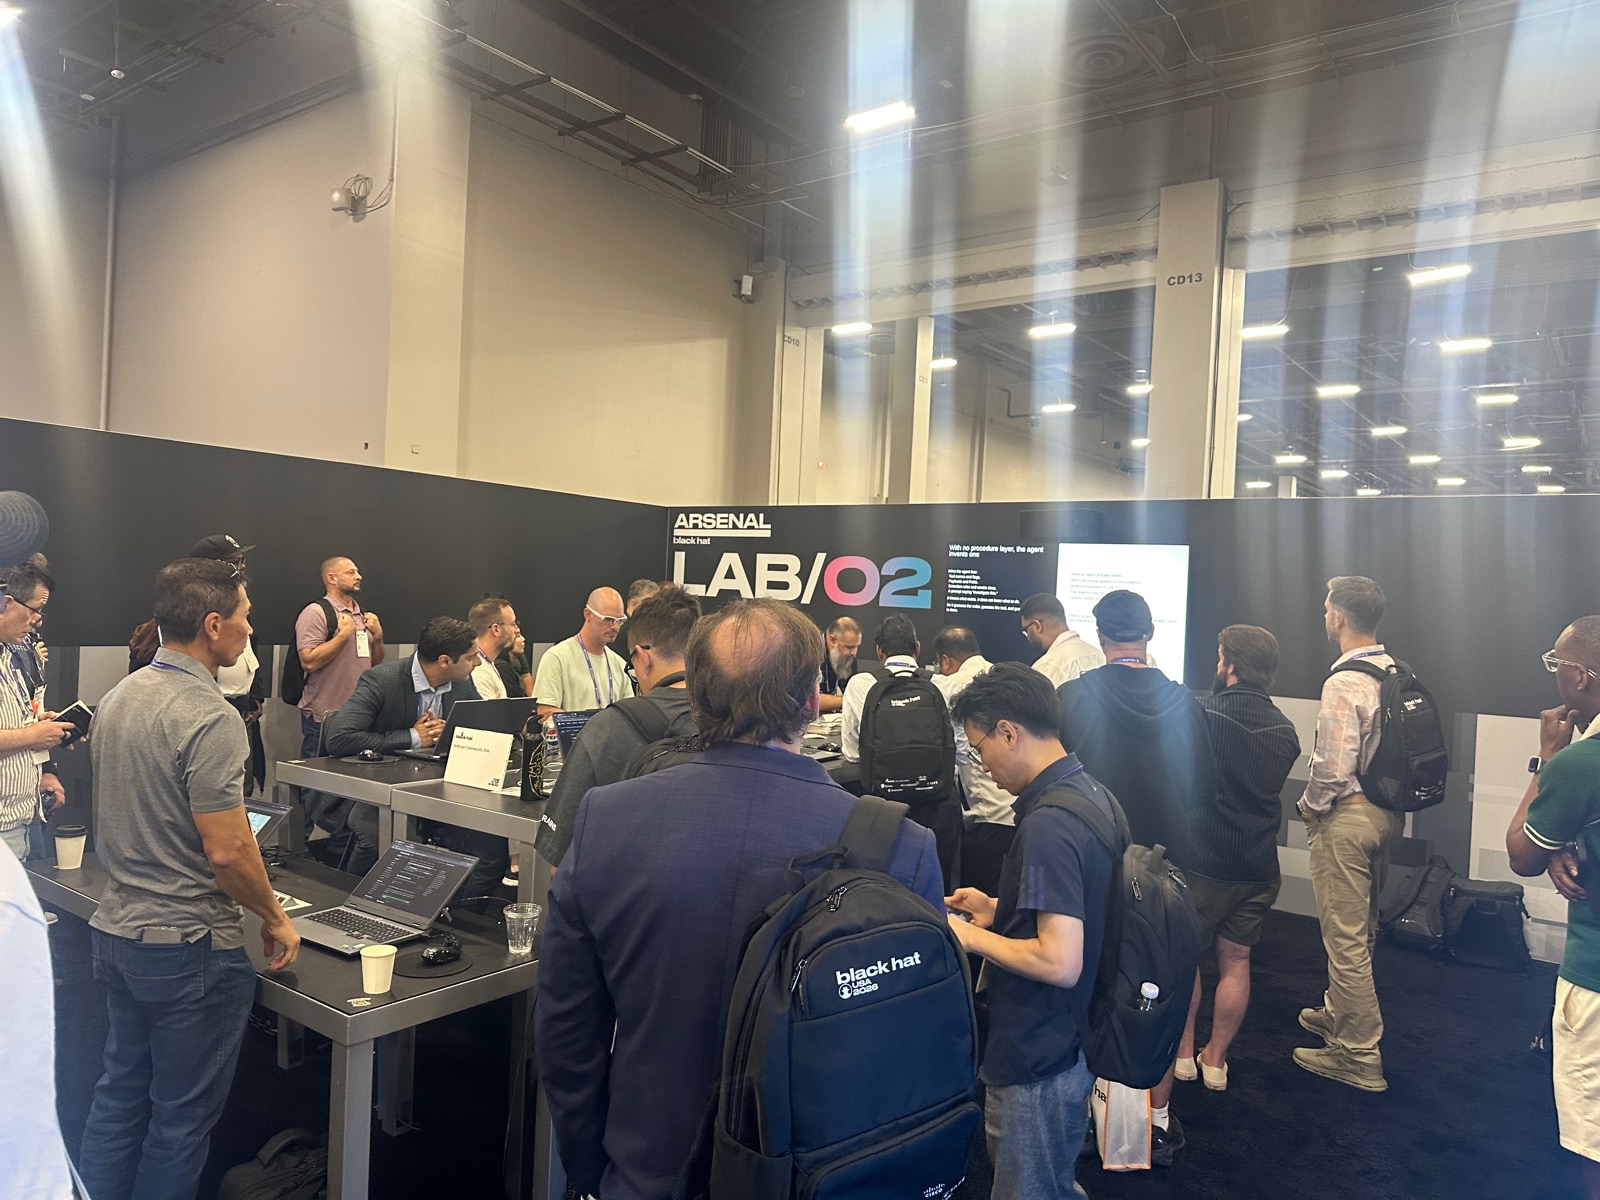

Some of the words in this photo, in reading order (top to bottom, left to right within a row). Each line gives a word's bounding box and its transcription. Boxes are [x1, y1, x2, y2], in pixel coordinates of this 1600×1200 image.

[1167, 272, 1202, 286] CD13
[784, 334, 800, 346] CD10
[674, 513, 772, 528] ARSENAL
[697, 537, 711, 545] hat
[836, 960, 890, 985] black
[890, 952, 921, 971] hat
[852, 978, 872, 988] USA
[852, 984, 878, 996] 2026
